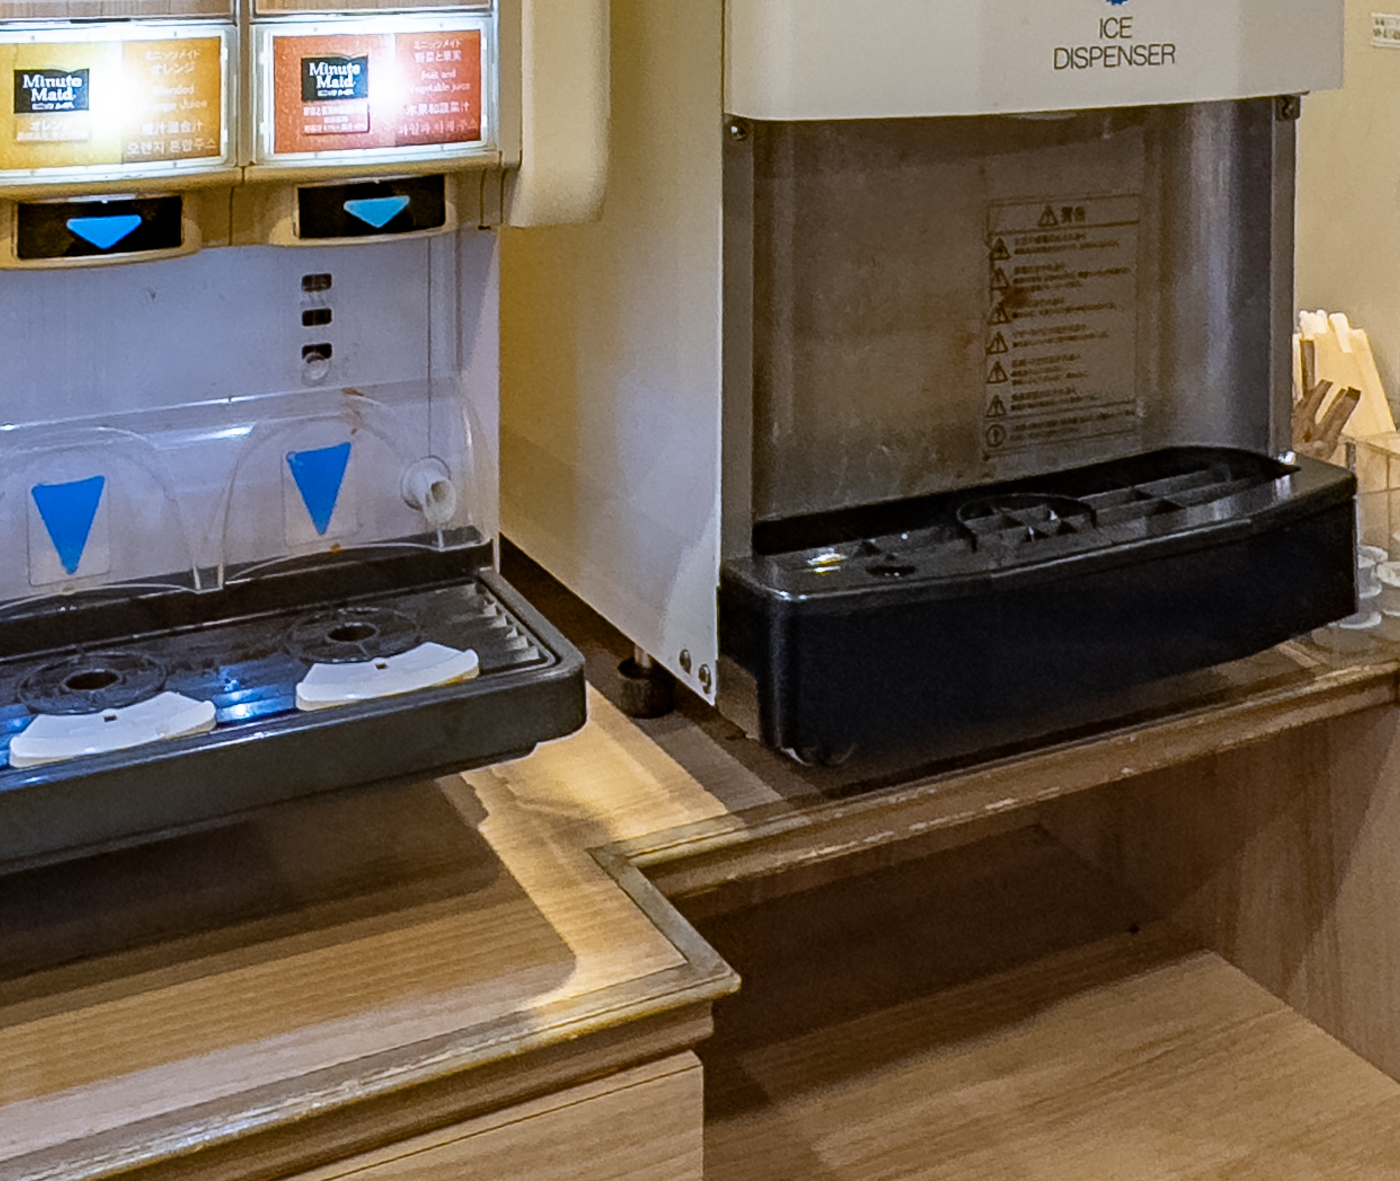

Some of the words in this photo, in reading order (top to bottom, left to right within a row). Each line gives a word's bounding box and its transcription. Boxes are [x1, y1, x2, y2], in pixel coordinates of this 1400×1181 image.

[1099, 16, 1133, 40] ICE
[1053, 43, 1176, 69] DISPENSER
[309, 62, 360, 76] Minute
[23, 74, 82, 88] Minute
